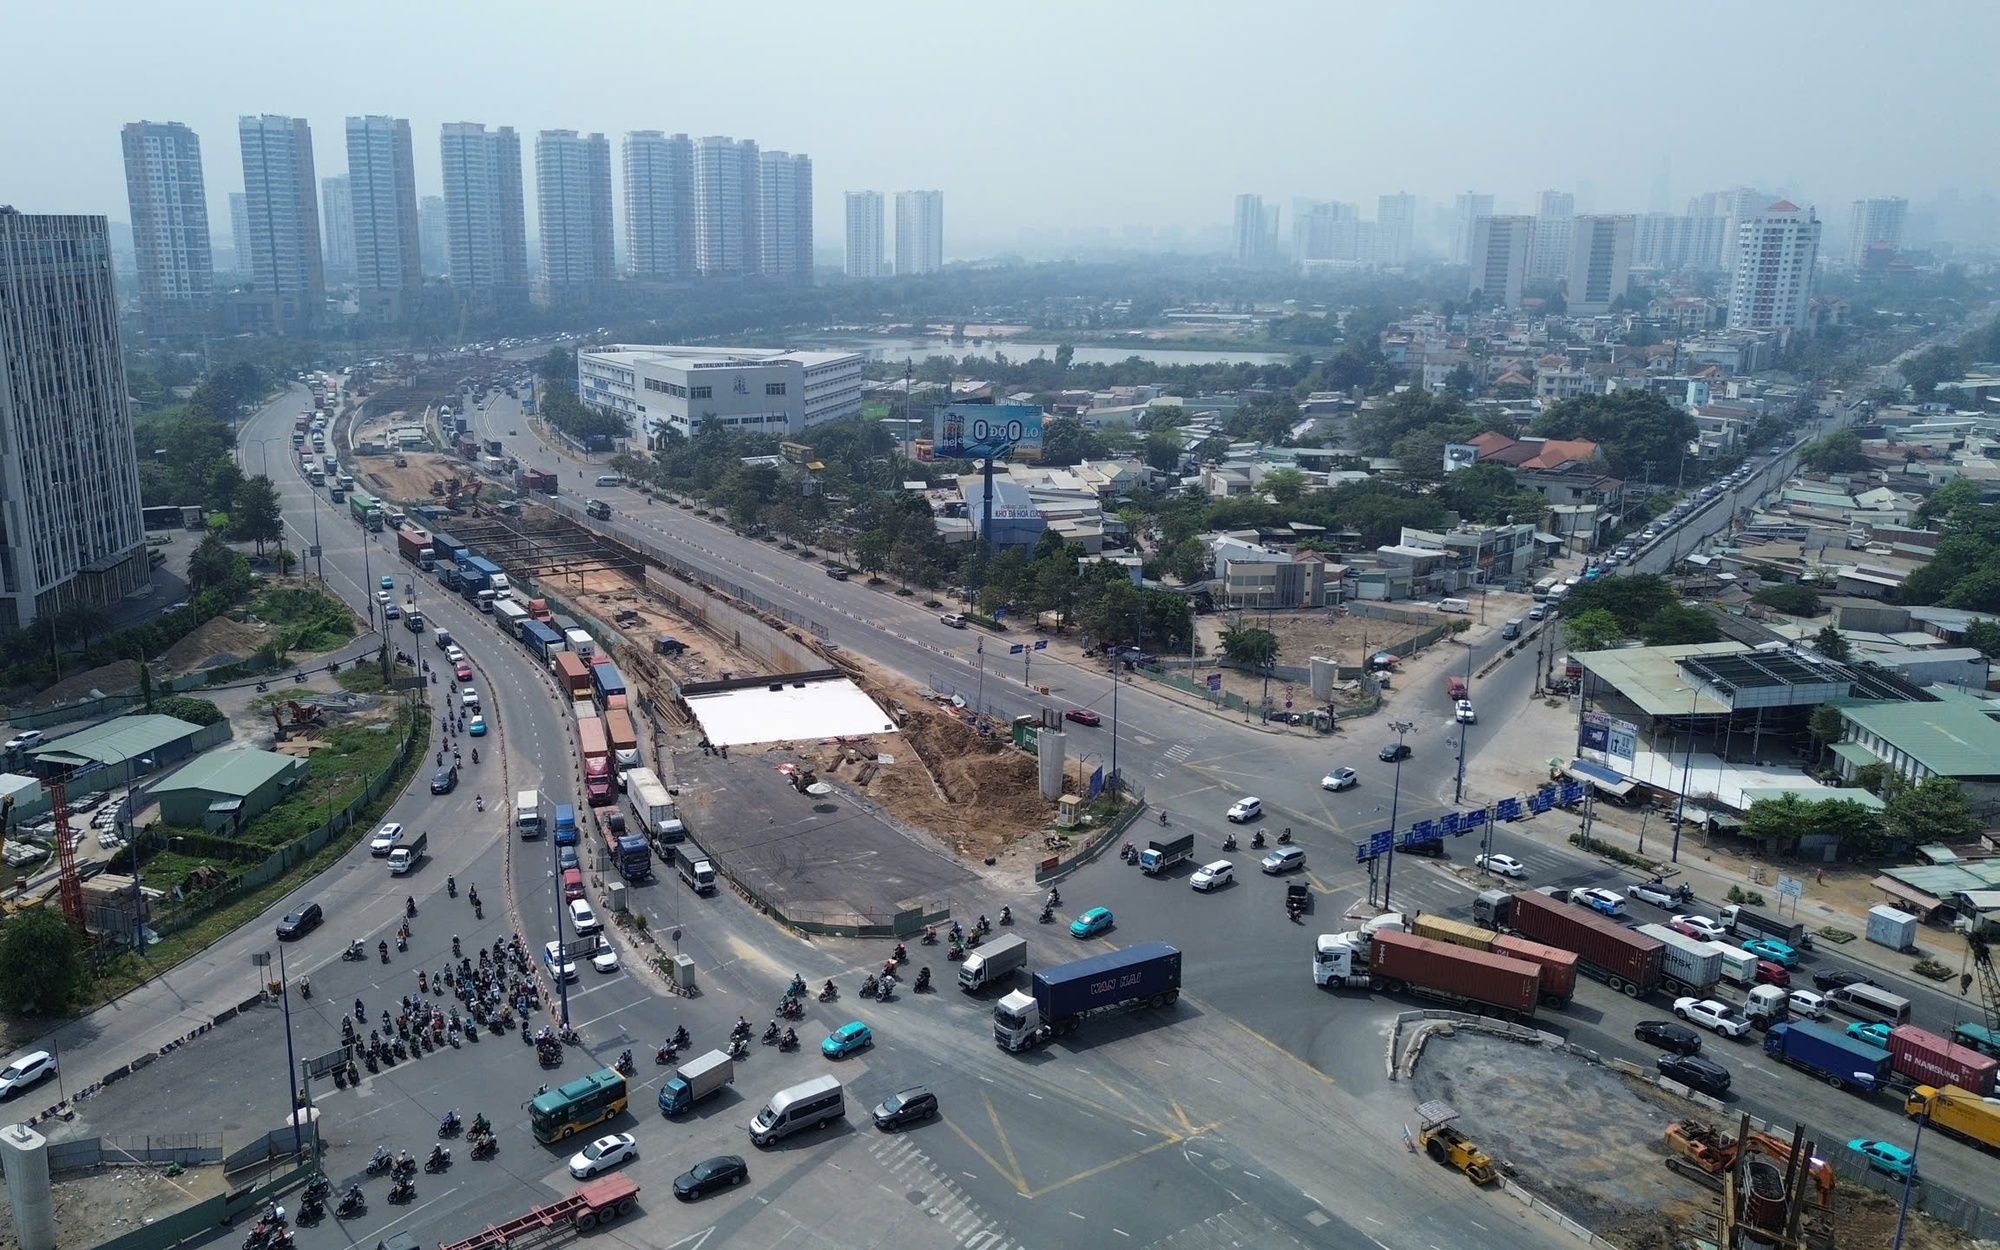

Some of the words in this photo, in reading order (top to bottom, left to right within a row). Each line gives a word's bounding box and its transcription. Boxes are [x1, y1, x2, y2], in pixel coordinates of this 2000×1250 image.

[995, 509, 1007, 517] KHO
[1091, 979, 1116, 994] WAN
[1120, 972, 1142, 987] HAI
[1914, 1058, 1959, 1082] NAMSUNG
